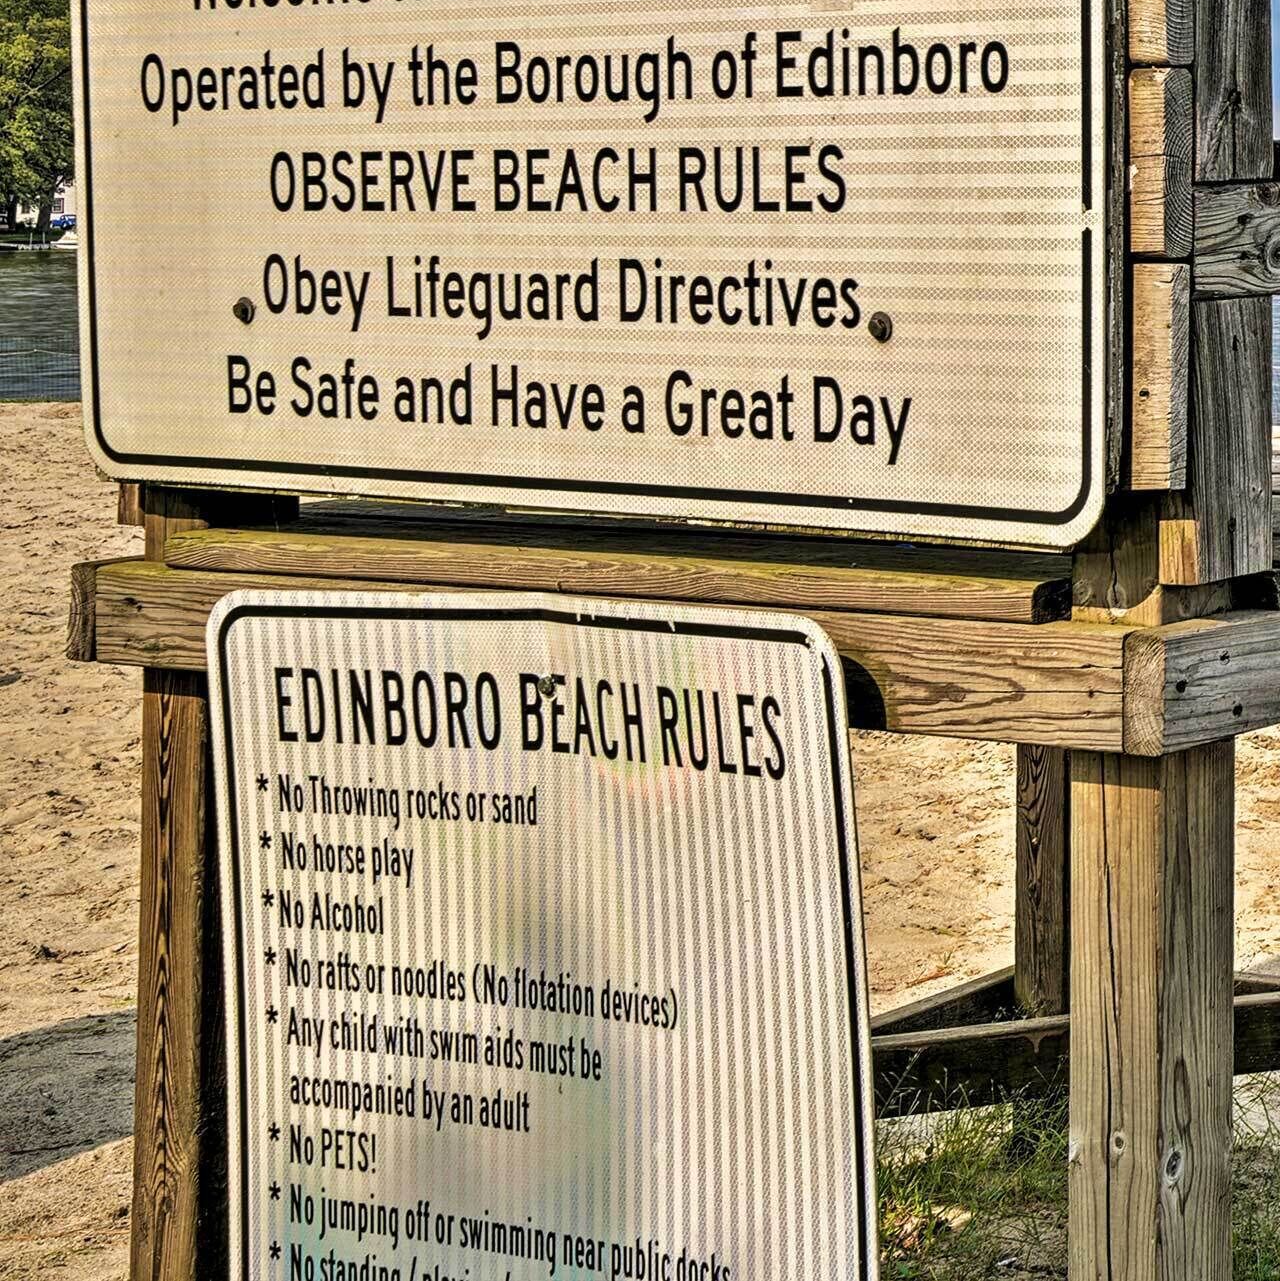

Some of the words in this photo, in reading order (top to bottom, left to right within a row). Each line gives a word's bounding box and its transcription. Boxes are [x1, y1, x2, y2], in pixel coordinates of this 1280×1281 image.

[140, 47, 325, 127] Operated
[342, 47, 395, 124] by
[407, 44, 478, 107] the
[495, 35, 693, 124] Borough
[711, 31, 757, 100] of
[775, 26, 1009, 98] Edinboro
[270, 149, 476, 213] OBSERVE
[493, 146, 657, 213] BEACH
[678, 144, 846, 213] RULES
[263, 253, 371, 332] Obey
[386, 255, 599, 341] Lifeguard
[618, 257, 861, 329] Directives
[227, 354, 277, 416] Be
[290, 356, 380, 421] Safe
[394, 362, 472, 426] and
[491, 364, 605, 432] Have
[621, 385, 645, 434] a
[665, 369, 795, 442] Great
[813, 375, 913, 466] Day
[274, 667, 501, 751] EDINBORO
[518, 673, 647, 764] BEACH
[656, 685, 786, 781] RULES
[277, 774, 304, 813] No
[308, 775, 400, 831] Throwing
[406, 780, 461, 821] rocks
[466, 791, 486, 822] or
[492, 785, 537, 826] sand
[280, 831, 307, 871] No
[312, 833, 365, 875] horse
[371, 837, 414, 889] play
[279, 889, 304, 930] No
[310, 891, 384, 935] Alcohol
[286, 948, 311, 988] No
[317, 951, 361, 992] rafts
[365, 964, 385, 994] or
[391, 959, 466, 1002] noodles
[472, 963, 508, 1007] (No
[514, 966, 594, 1018] flotation
[600, 978, 678, 1030] devices)
[286, 1006, 325, 1059] Any
[330, 1011, 377, 1053] child
[383, 1017, 424, 1058] with
[430, 1029, 478, 1064] swim
[484, 1025, 524, 1070] aids
[529, 1035, 575, 1078] must
[580, 1037, 602, 1082] be
[290, 1075, 415, 1121] accompanied
[422, 1078, 446, 1132] by
[450, 1092, 473, 1125] an
[479, 1088, 530, 1133] adult
[289, 1124, 314, 1166] No
[321, 1128, 376, 1175] PETS!
[290, 1183, 314, 1226] No
[318, 1187, 399, 1251] jumping
[405, 1199, 430, 1243] off
[435, 1213, 455, 1246] or
[459, 1209, 556, 1277] swimming
[563, 1234, 606, 1272] near
[611, 1236, 671, 1281] public
[676, 1247, 731, 1281] docks
[290, 1243, 315, 1281] No
